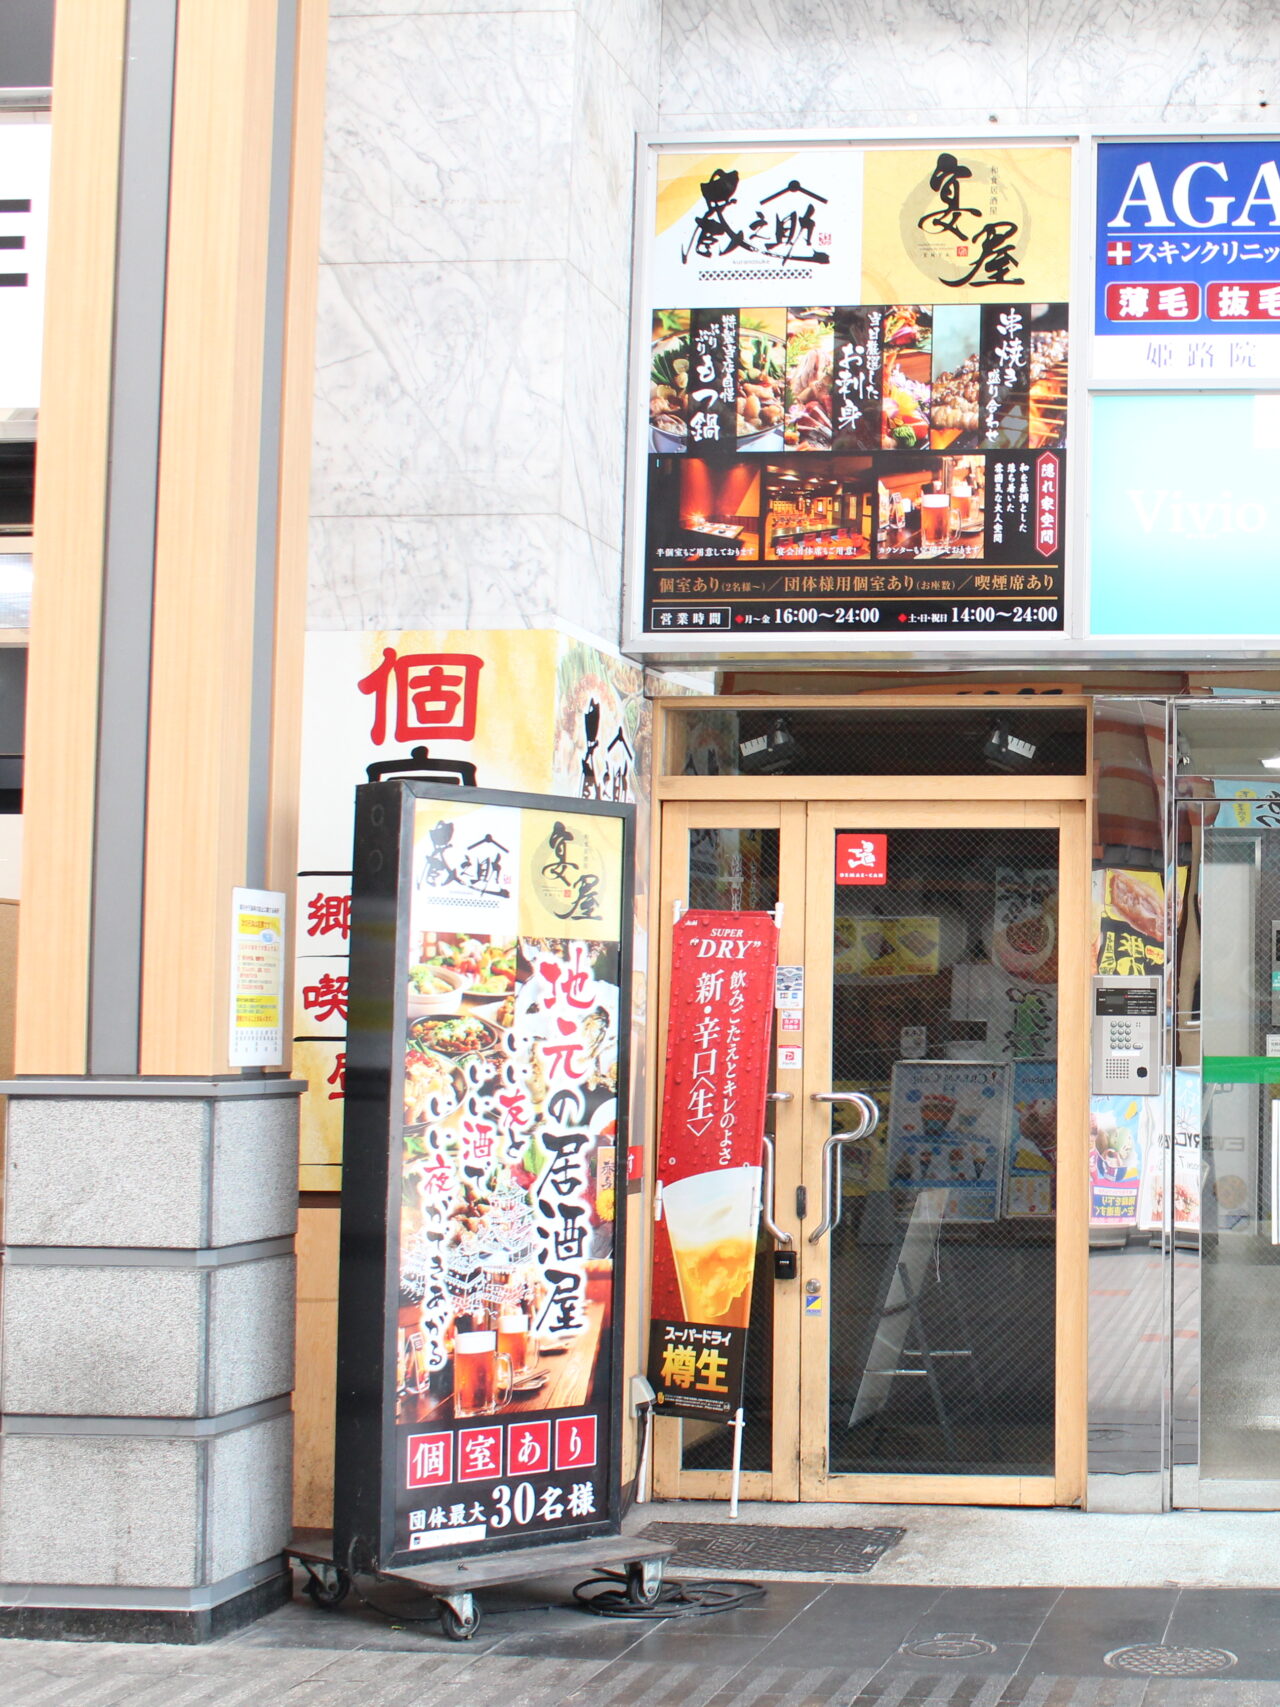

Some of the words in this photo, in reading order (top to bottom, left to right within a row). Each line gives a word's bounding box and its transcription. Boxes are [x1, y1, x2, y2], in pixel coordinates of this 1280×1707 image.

[917, 152, 1026, 288] 宴屋
[1118, 285, 1190, 319] 薄毛
[995, 307, 1027, 388] 串焼き
[1146, 341, 1258, 368] 姫路院
[690, 354, 721, 442] もつ鍋
[835, 342, 865, 430] お刺身
[985, 368, 1002, 443] 盛り合わせ
[1126, 488, 1269, 535] Vivio
[660, 612, 722, 626] 営業時間
[710, 928, 744, 938] SUPER
[718, 970, 747, 1165] 飲みごたえとキレのよさ
[461, 1063, 495, 1188] いい酒で
[536, 947, 597, 1333] 地元の居酒屋
[664, 1325, 732, 1347] スーパードライ
[660, 1343, 729, 1393] 樽生
[412, 1426, 583, 1479] 個室あり
[409, 1481, 597, 1531] 団体最大30名様
